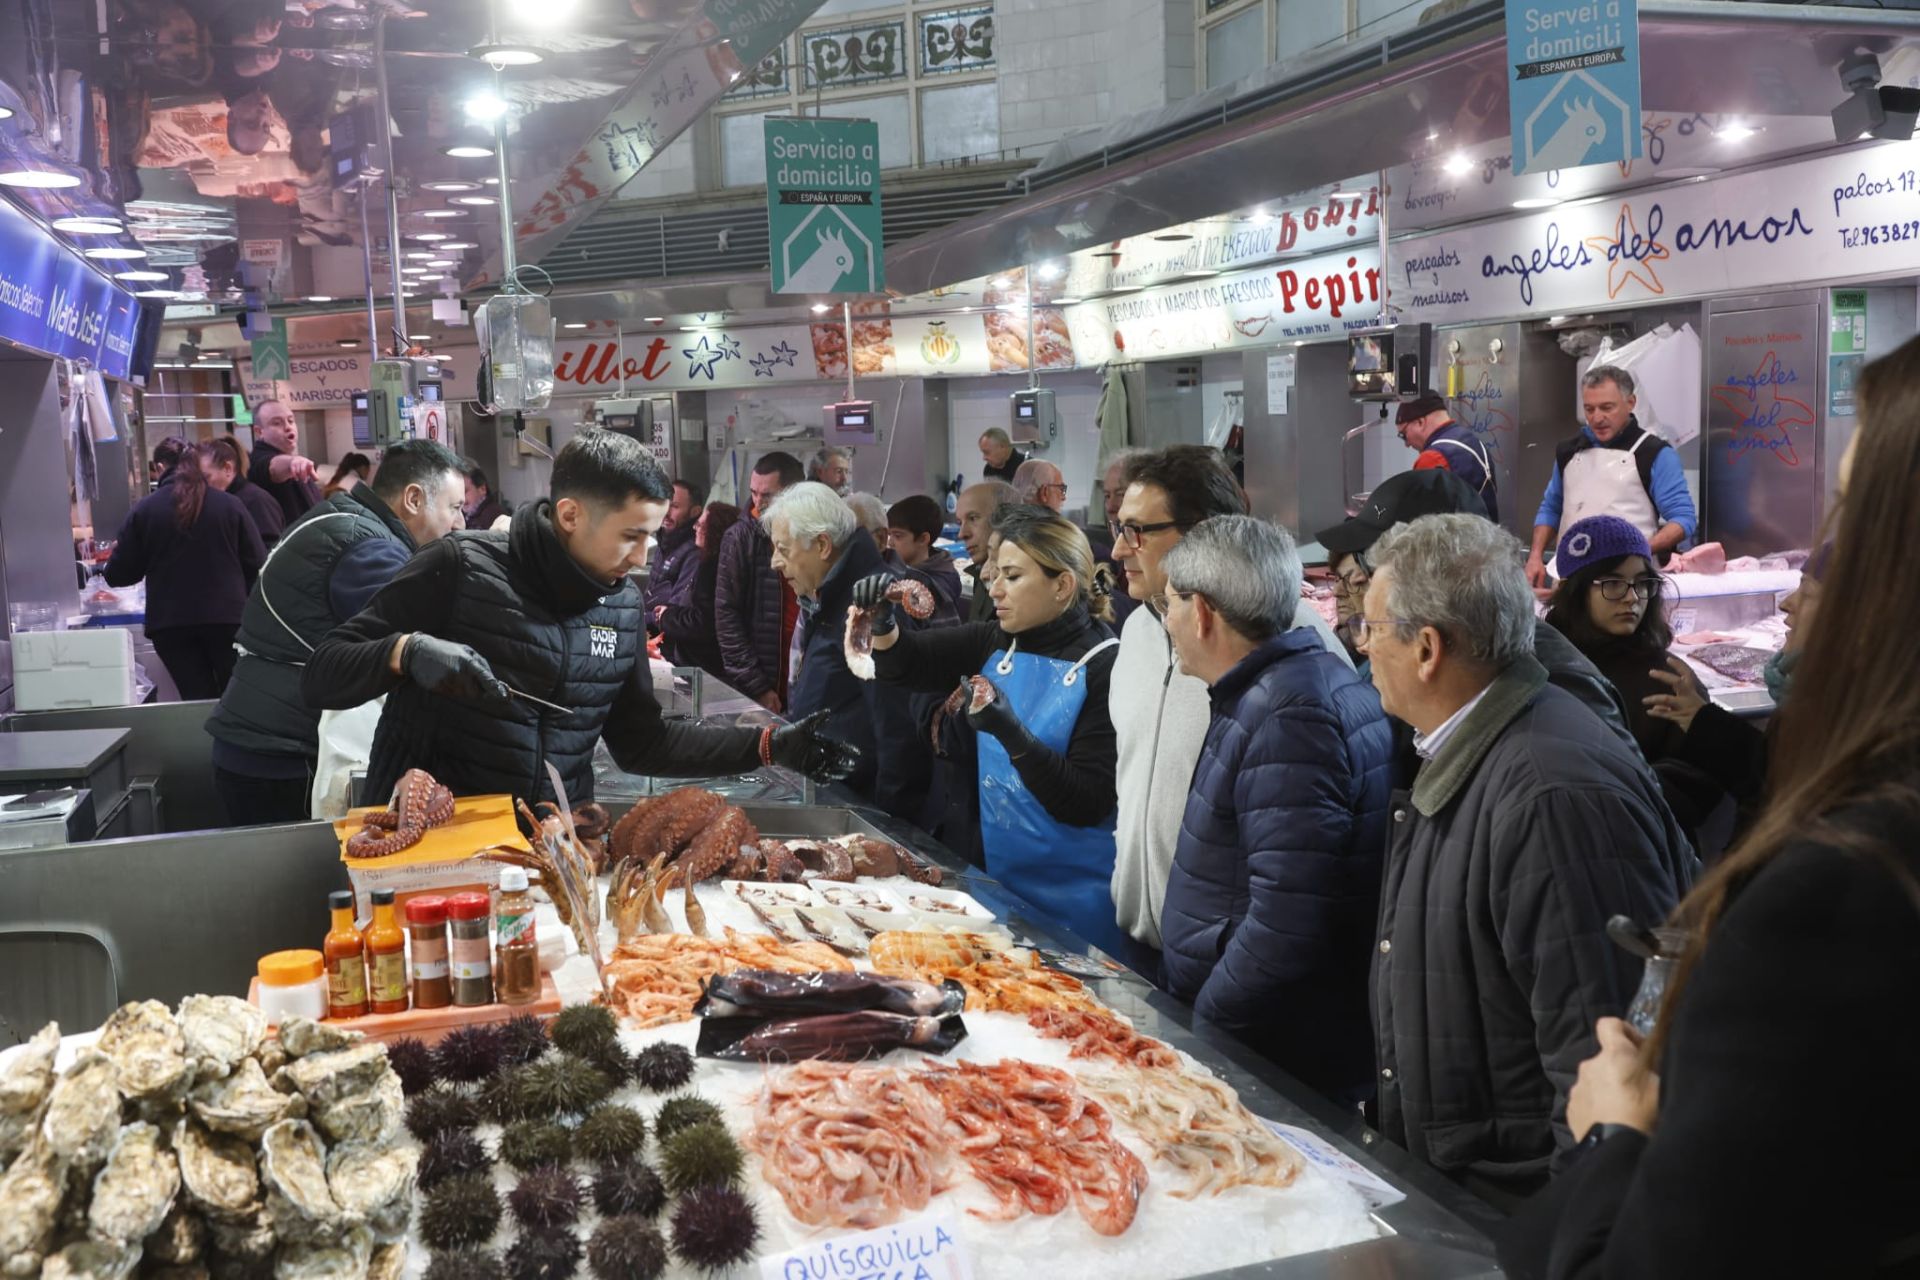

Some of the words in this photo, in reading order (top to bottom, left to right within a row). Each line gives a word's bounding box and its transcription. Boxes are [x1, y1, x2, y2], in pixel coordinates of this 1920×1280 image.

[1525, 0, 1598, 32] Servei
[1526, 22, 1621, 60] domicili
[1540, 59, 1576, 73] ESPANYA
[1584, 52, 1617, 65] EUROPA
[773, 136, 856, 159] Servicio
[862, 145, 873, 160] a
[777, 163, 872, 186] domicilio
[800, 191, 828, 203] ESPAÑA
[829, 194, 835, 202] Y
[835, 194, 863, 203] EUROPA
[1833, 173, 1895, 217] palcos
[1405, 247, 1461, 287] pescados
[1482, 222, 1592, 306] angeles
[1608, 204, 1662, 260] del
[1676, 208, 1813, 251] amor
[0, 272, 21, 309] ariscos
[1106, 300, 1153, 322] PESCADOS
[1223, 277, 1274, 305] FRESCOS
[1411, 289, 1470, 307] mariscos
[290, 358, 358, 374] ESCADOS
[554, 337, 673, 385] illot
[317, 375, 327, 386] Y
[1744, 401, 1781, 428] del
[1728, 433, 1792, 450] amor
[590, 628, 617, 645] GADIR
[591, 641, 615, 659] MAR
